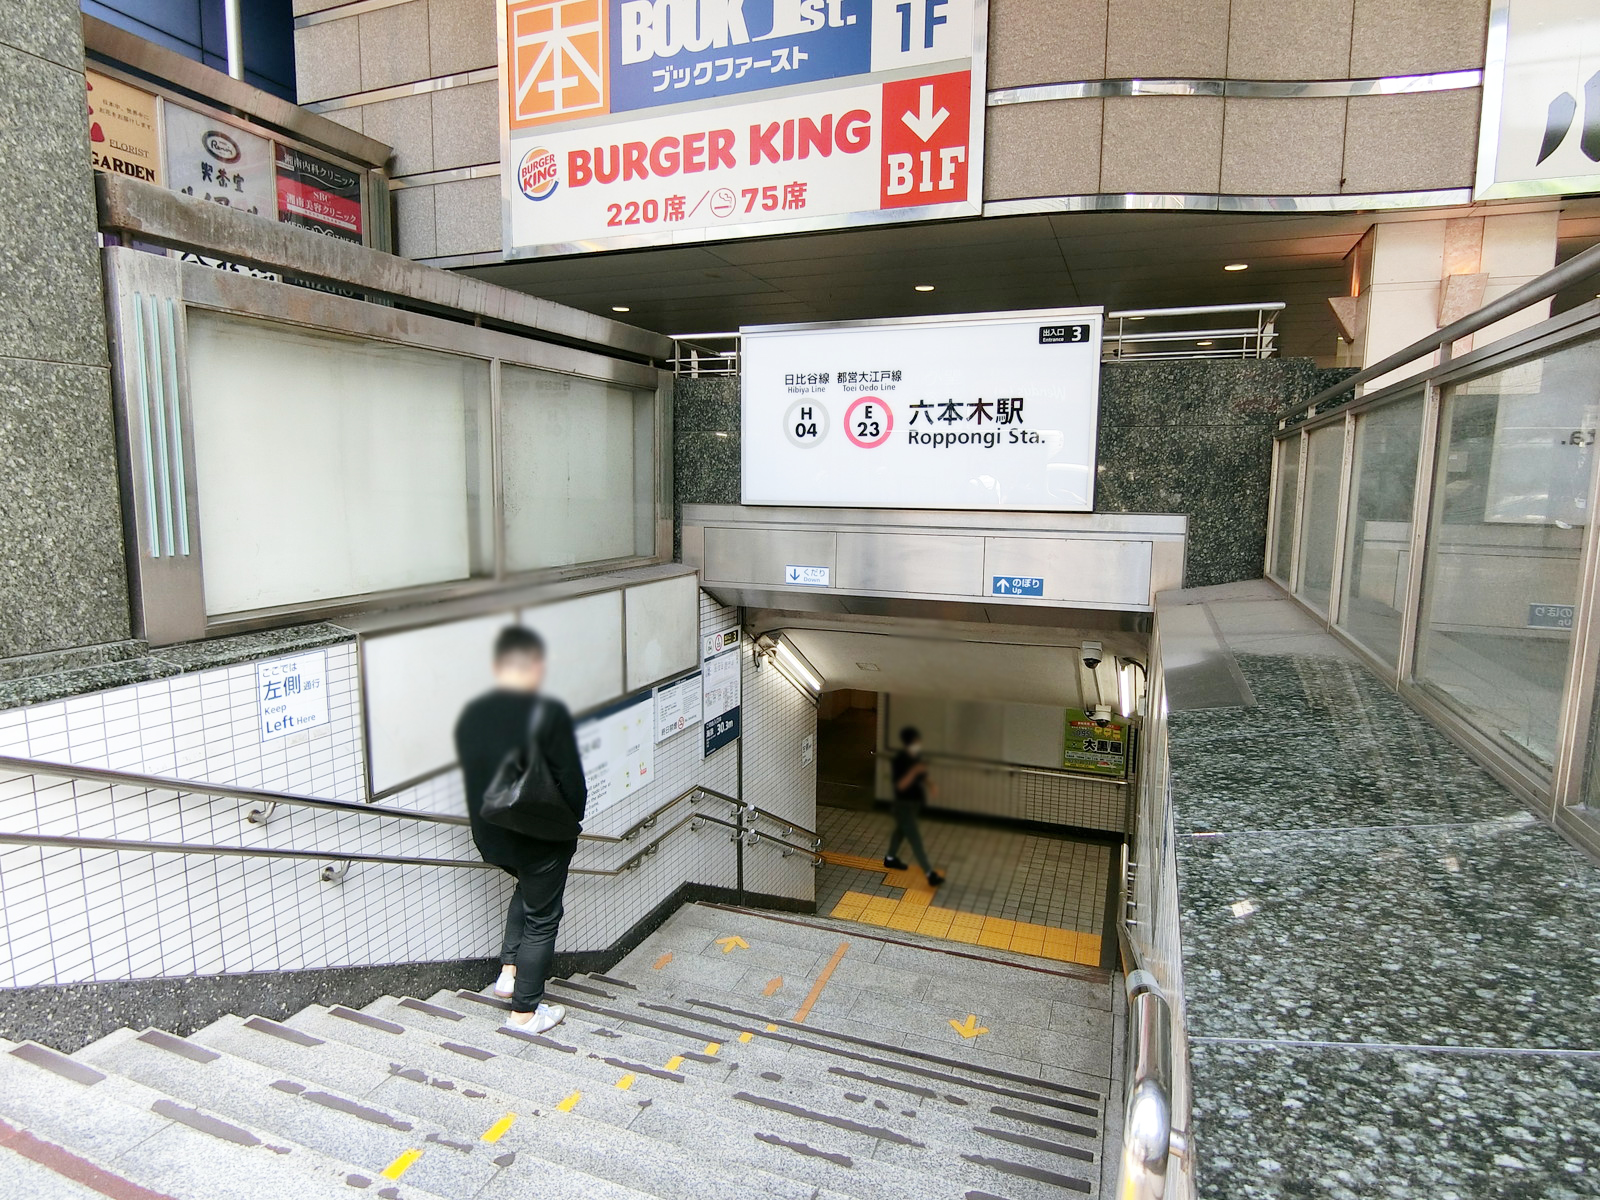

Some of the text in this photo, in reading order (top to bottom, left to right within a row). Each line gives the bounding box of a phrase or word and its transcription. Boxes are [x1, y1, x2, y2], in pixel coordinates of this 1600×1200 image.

[621, 0, 750, 65] BOOK
[896, 0, 950, 54] 1F
[652, 46, 809, 93] ブックファースト
[110, 139, 149, 158] FLORIST
[567, 109, 872, 188] BURGER KING
[522, 154, 555, 178] BURGER
[886, 146, 966, 196] B1F
[201, 161, 245, 193] 喫茶室
[523, 163, 557, 192] KING
[741, 181, 808, 213] 75席
[286, 192, 357, 223] 湘南美容クリニック
[1042, 326, 1082, 342] 出入口 3
[784, 372, 830, 386] 日比谷線
[836, 369, 903, 384] 都営大江戸線
[787, 386, 810, 395] Hibiya
[842, 383, 896, 392] Toei Oedo Line
[800, 407, 813, 420] H
[864, 405, 873, 419] E
[908, 397, 1024, 426] 六本木駅
[795, 423, 818, 438] 04
[857, 421, 880, 437] 23
[908, 427, 1046, 449] Roppongi Sta.
[803, 568, 826, 577] くだり
[1012, 578, 1040, 588] のぼり
[1012, 587, 1022, 595] Up
[262, 662, 298, 678] ここでは
[264, 704, 287, 716] Keep
[266, 715, 316, 734] Left Here
